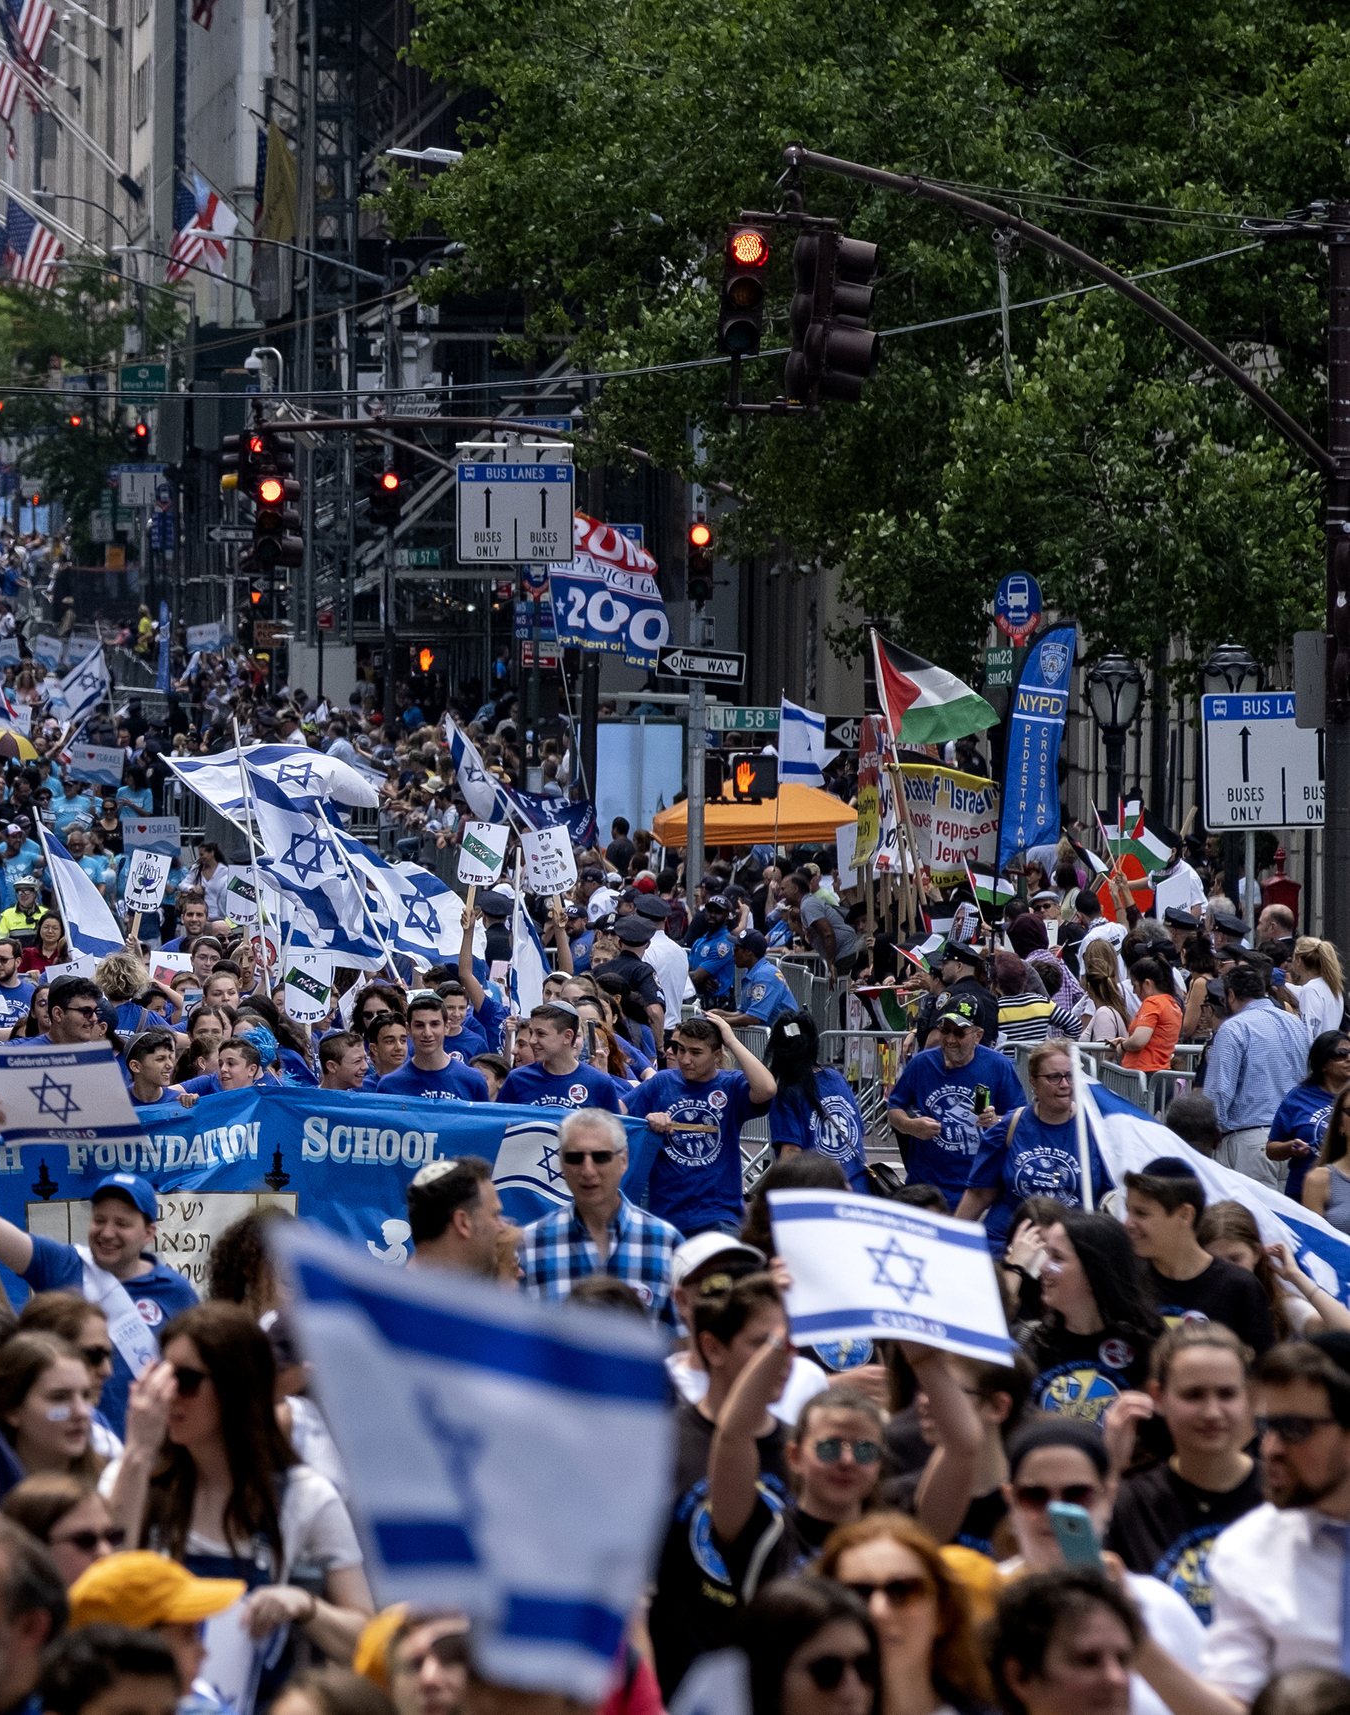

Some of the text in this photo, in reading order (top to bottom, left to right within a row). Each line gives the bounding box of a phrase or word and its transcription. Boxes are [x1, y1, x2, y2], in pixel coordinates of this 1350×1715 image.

[486, 467, 546, 480] BUS LANES
[474, 532, 502, 543] BUSES
[530, 532, 558, 543] BUSES
[408, 551, 431, 563] W 57
[476, 546, 500, 557] ONLY
[532, 546, 556, 557] ONLY
[671, 656, 733, 673] ONE WAY
[987, 650, 1013, 666] SIM23
[988, 670, 1013, 686] SIM24
[1018, 692, 1063, 715] NYPD
[1242, 700, 1271, 716] BUS
[725, 710, 780, 728] W 58 ST
[841, 727, 860, 740] ON
[97, 754, 122, 765] ISRAEL
[1036, 727, 1049, 825] CROSSING
[1016, 724, 1032, 847] PEDESTRIAN
[1227, 787, 1265, 803] BUSES
[1303, 786, 1326, 800] BUS
[1230, 806, 1262, 821] ONLY
[1306, 805, 1323, 820] ON
[125, 824, 178, 834] NY ISRAEL
[477, 822, 492, 832] רק
[936, 819, 999, 843] represe
[537, 832, 552, 842] רק
[145, 853, 159, 861] רק
[459, 870, 494, 883] בישראל
[533, 877, 575, 893] בישראל
[124, 896, 159, 911] בישראל
[229, 911, 259, 922] ישראל
[304, 955, 317, 964] רק
[65, 962, 79, 973] רק
[289, 1008, 326, 1020] בישראל
[6, 1054, 78, 1068] Celebrate Israel
[67, 1121, 262, 1176] FOUNDATION
[301, 1115, 446, 1169] SCHOOL
[155, 1200, 205, 1222] ישיב
[153, 1231, 211, 1253] תפא
